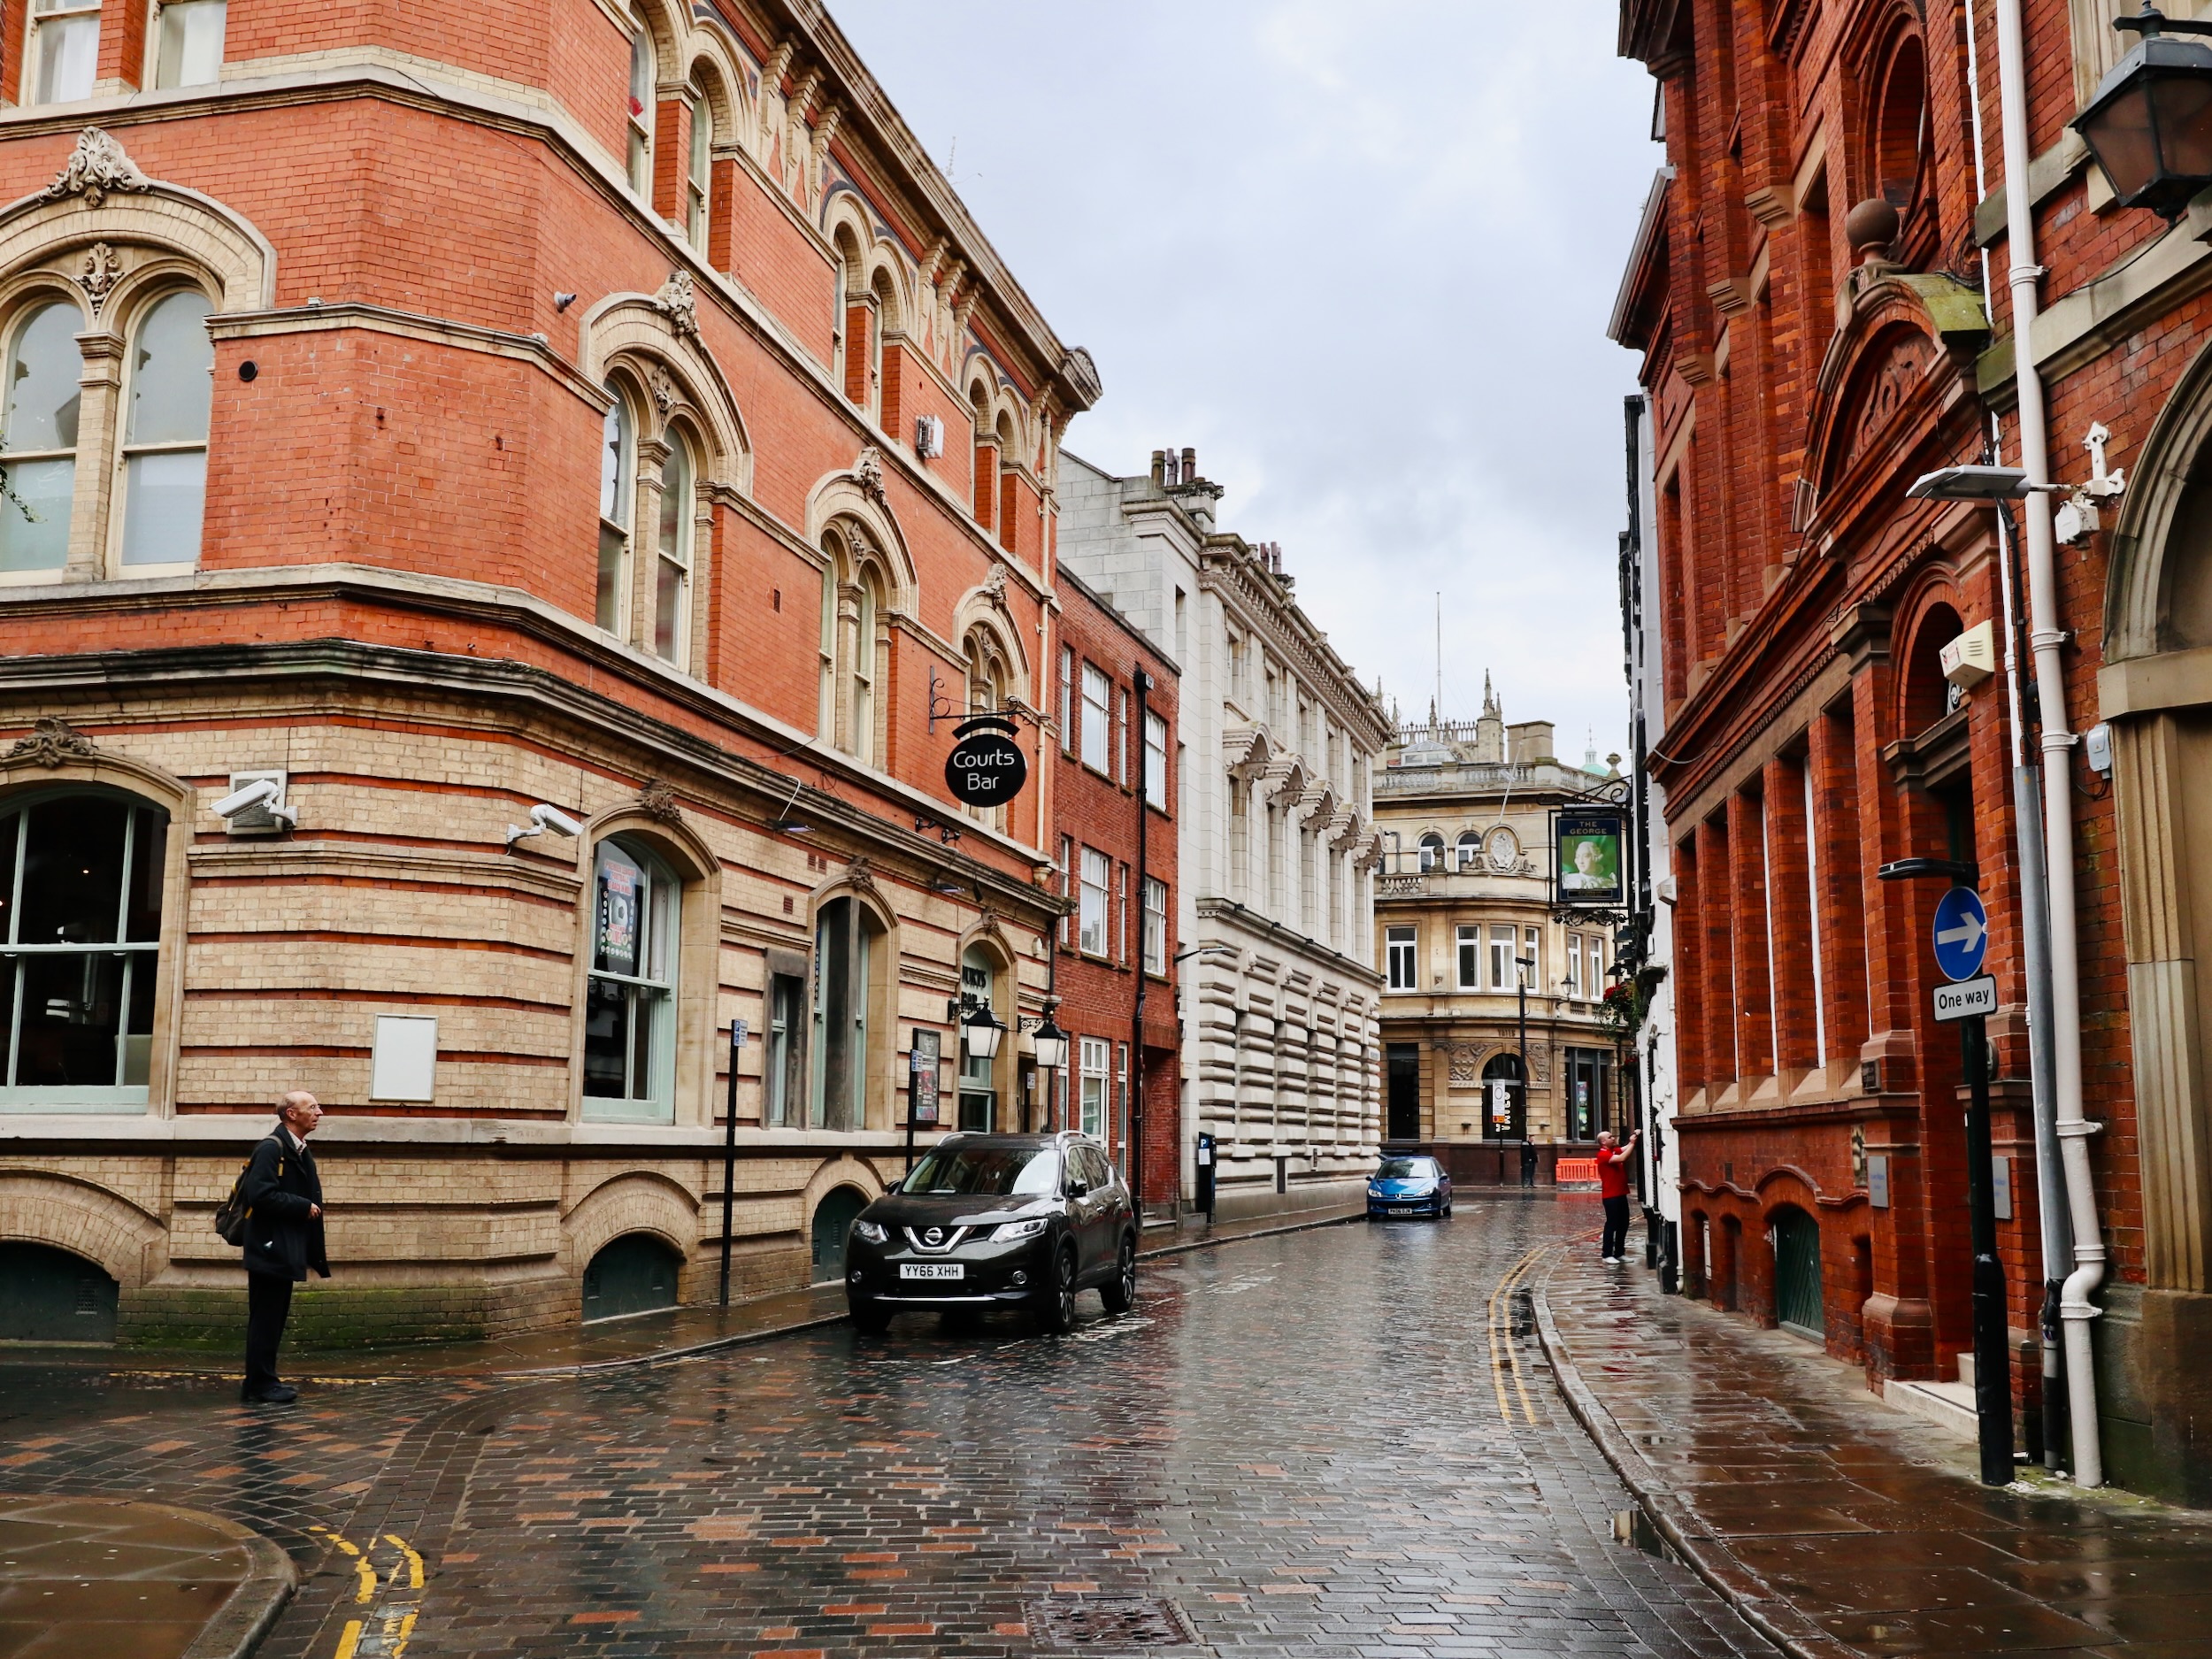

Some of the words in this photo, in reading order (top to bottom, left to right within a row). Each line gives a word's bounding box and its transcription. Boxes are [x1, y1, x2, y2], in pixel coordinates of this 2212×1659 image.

[953, 749, 1015, 768] Courts
[967, 772, 1000, 791] Bar
[1939, 994, 1962, 1010] One
[1965, 989, 1989, 1005] way
[905, 1265, 933, 1277] YY66
[937, 1265, 958, 1277] XHH
